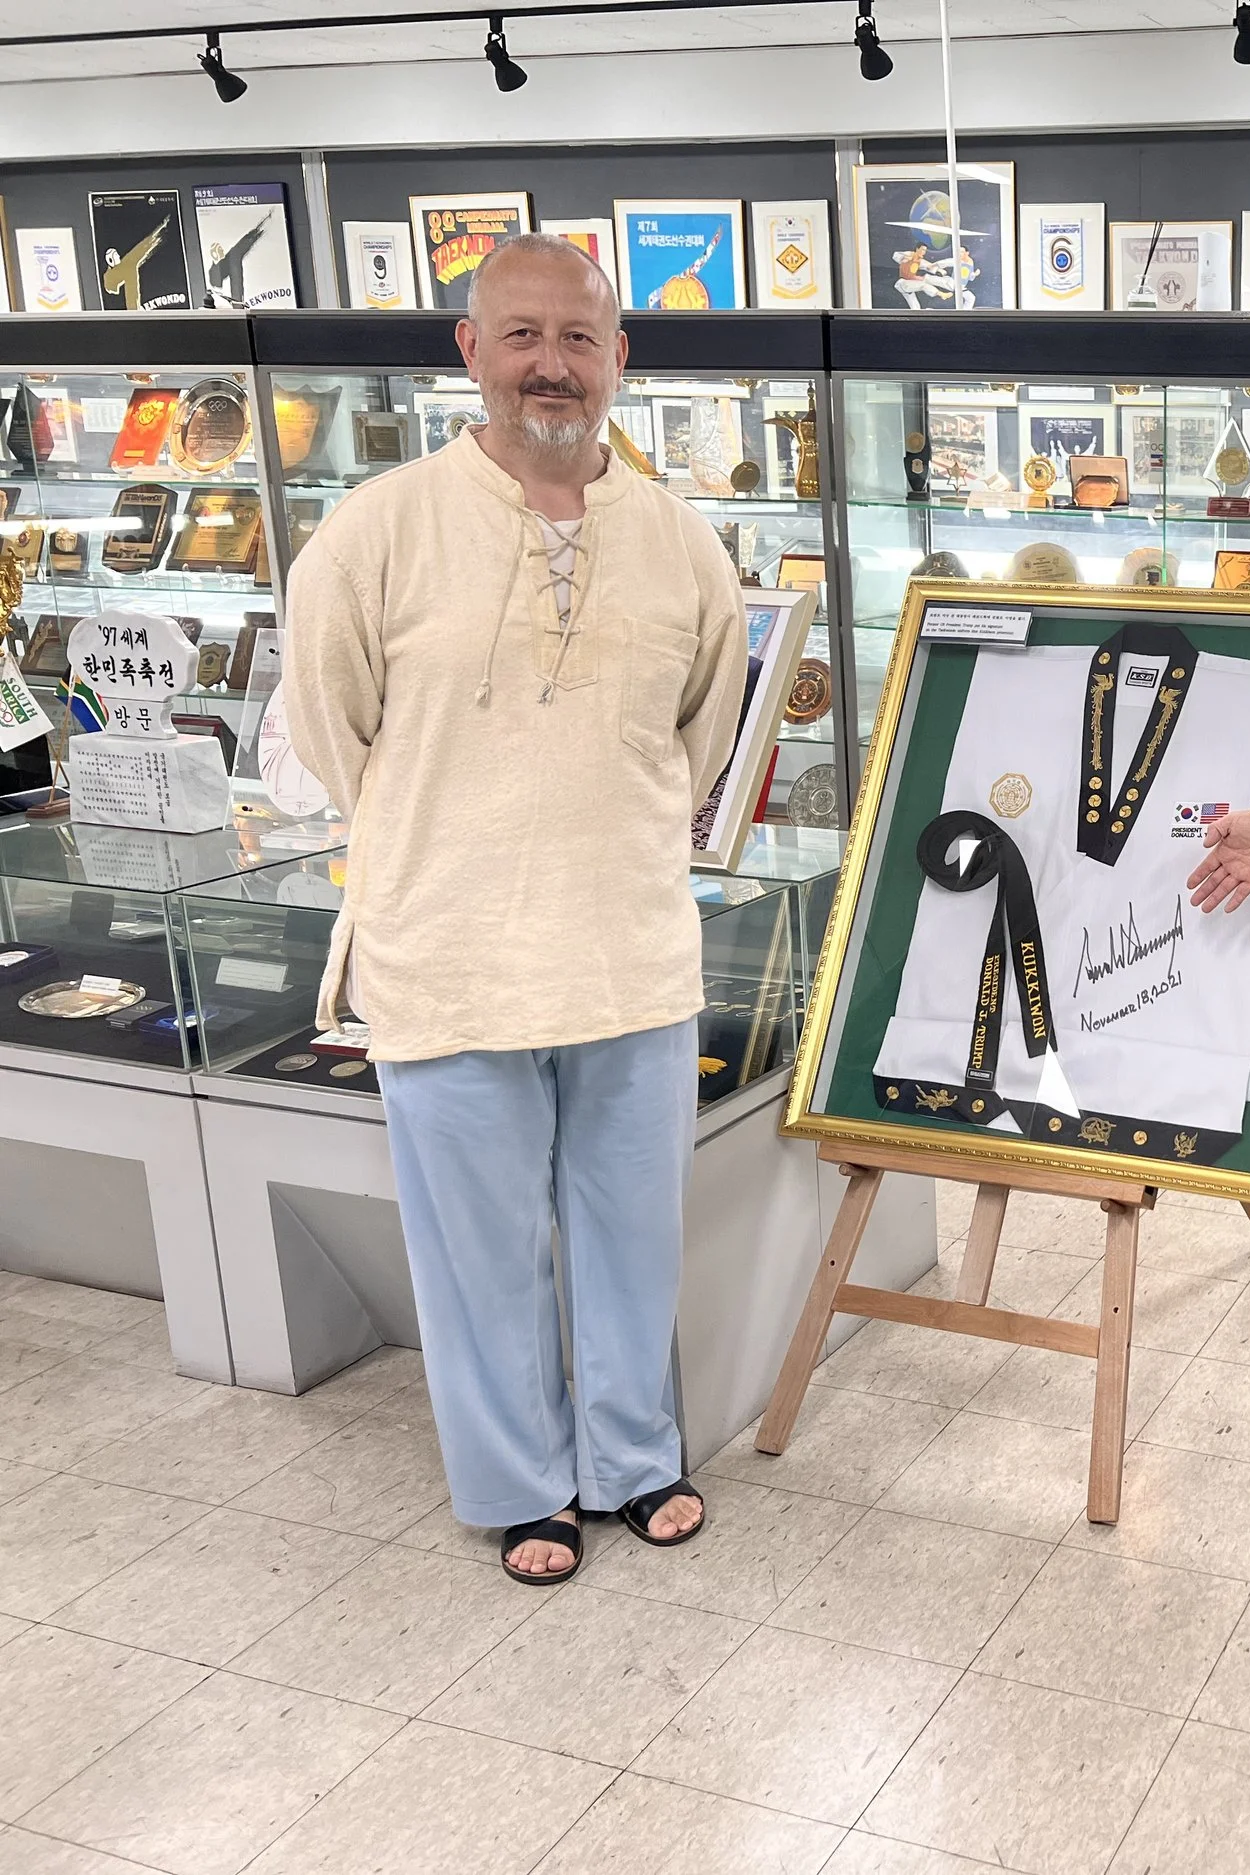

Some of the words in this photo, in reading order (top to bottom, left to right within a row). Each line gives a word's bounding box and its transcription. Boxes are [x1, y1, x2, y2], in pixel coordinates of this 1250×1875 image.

[637, 220, 658, 233] 제7회
[120, 627, 149, 651] 세계
[83, 653, 175, 689] 한민족축전
[7, 677, 38, 718] SOUTH
[981, 955, 995, 1007] DONALD
[1021, 940, 1046, 1039] KUKKIWON
[972, 1025, 987, 1069] TRUMP
